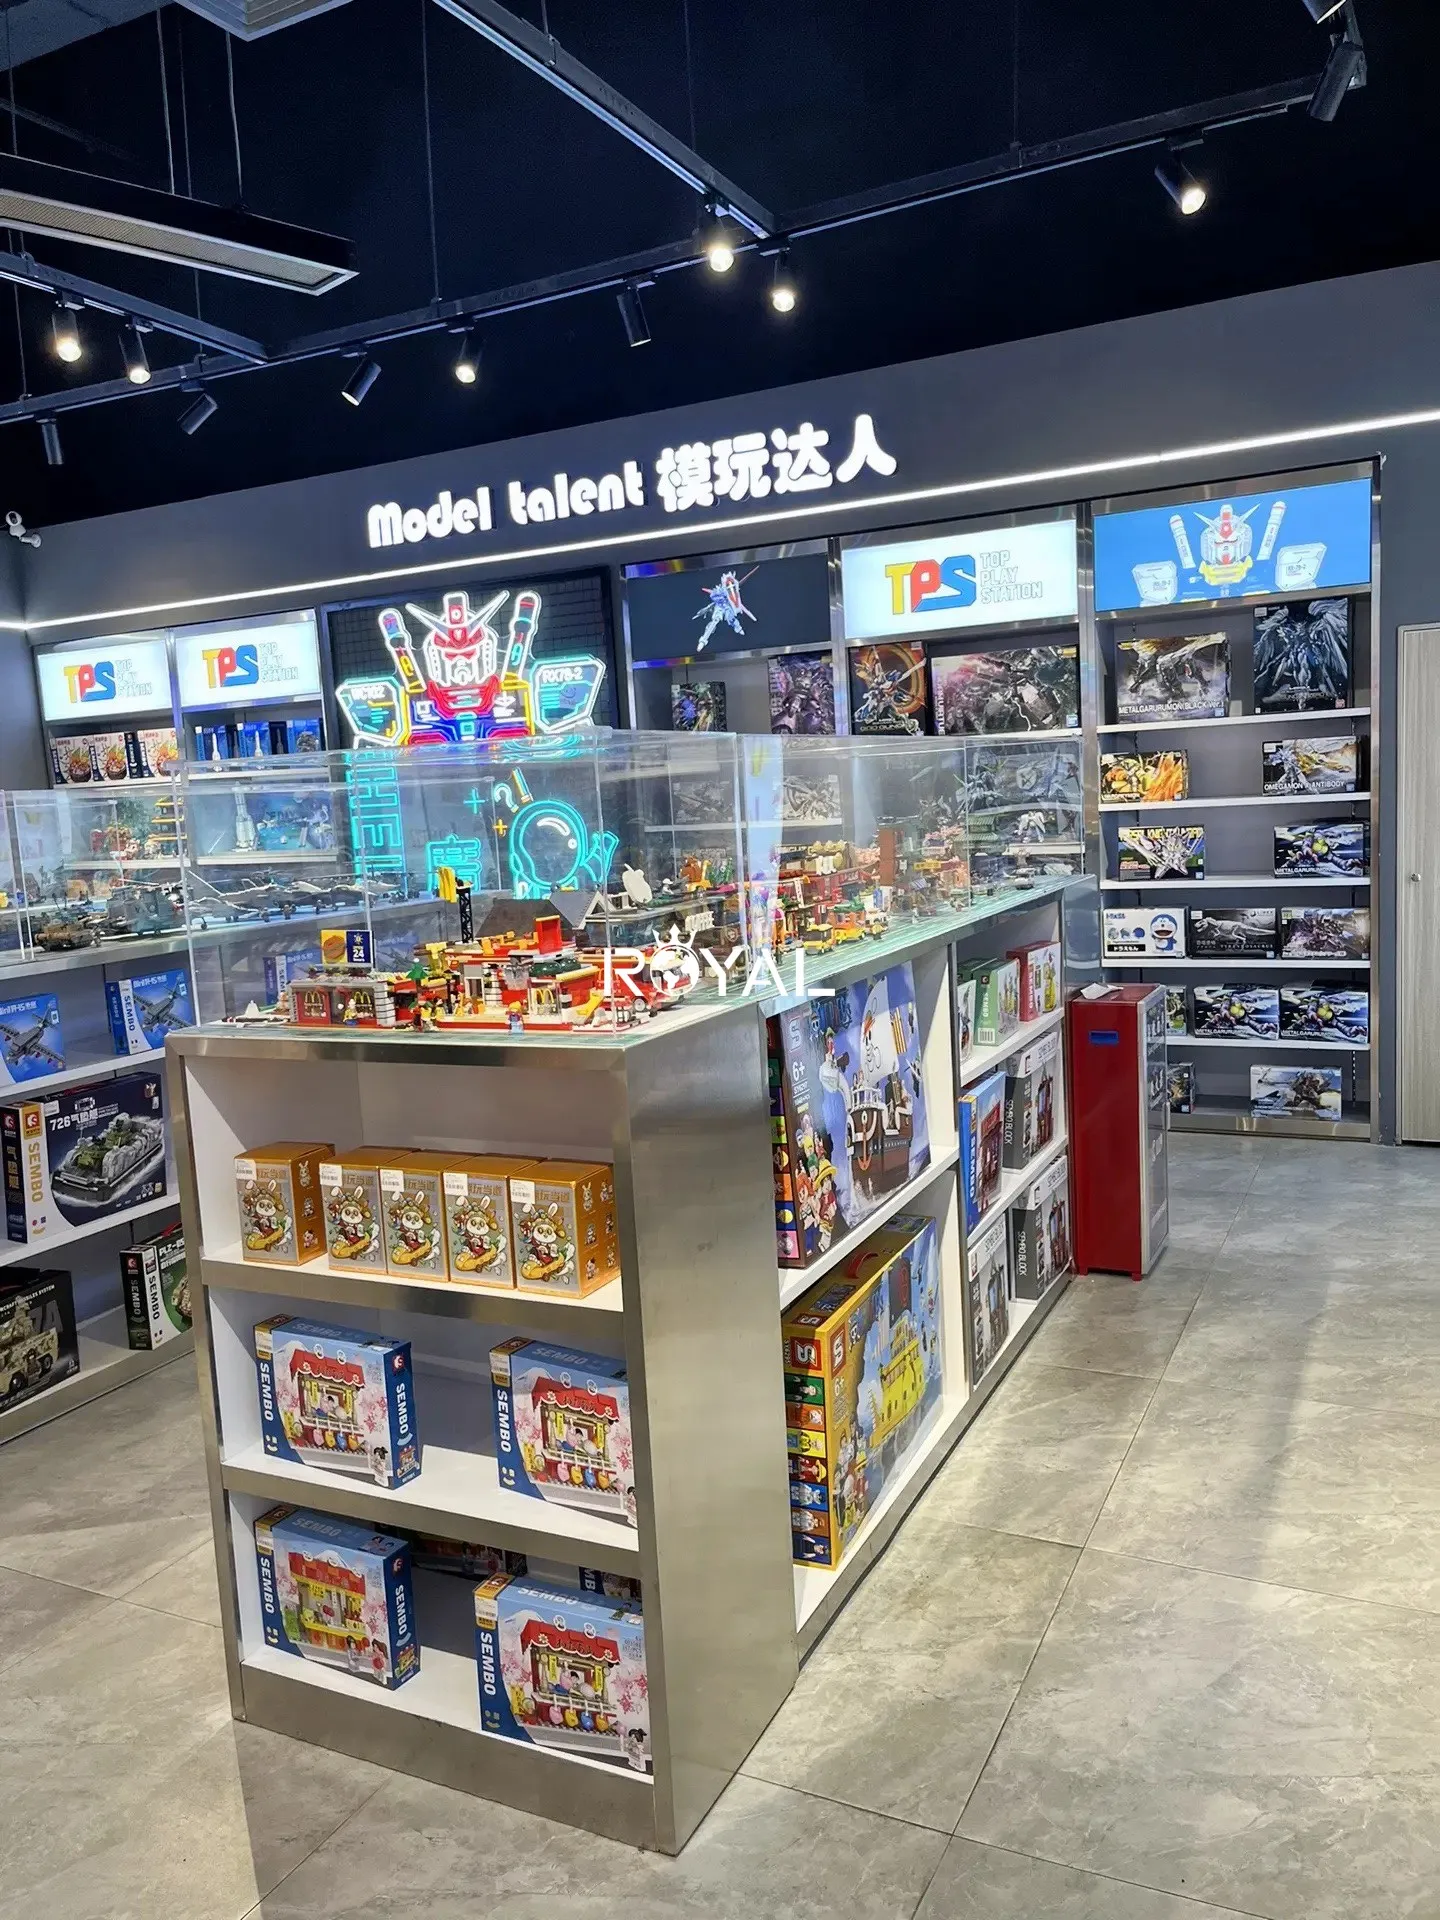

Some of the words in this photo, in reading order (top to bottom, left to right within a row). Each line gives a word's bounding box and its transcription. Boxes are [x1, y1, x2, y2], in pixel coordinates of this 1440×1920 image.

[656, 413, 897, 513] 模玩达人
[368, 486, 493, 548] Model
[509, 460, 645, 525] talent
[980, 550, 1010, 569] TOP
[980, 566, 1018, 587] PLAY
[885, 555, 977, 615] TPS
[981, 581, 1043, 604] STATION
[63, 661, 116, 704] TPS
[202, 644, 259, 689] TPS
[124, 995, 135, 1031] SEMBO
[792, 1061, 806, 1081] 6+
[1005, 1099, 1014, 1122] SEMBO
[1004, 1123, 1014, 1145] BLOCK
[28, 1142, 44, 1203] SEMBO
[969, 1136, 978, 1199] SEMBO
[1018, 1230, 1026, 1254] SEMBO
[1018, 1254, 1026, 1276] BLOCK
[39, 1284, 55, 1295] SYSTEM
[131, 1279, 141, 1316] SEMBO
[149, 1275, 160, 1320] SEMBO
[532, 1348, 588, 1365] SEMBO
[259, 1362, 274, 1421] SEMBO
[834, 1376, 845, 1397] 6+
[396, 1382, 409, 1435] SEMBO
[497, 1389, 511, 1453] SEMBO
[292, 1518, 342, 1537] SEMBO
[260, 1557, 275, 1614] SEMBO
[517, 1587, 579, 1605] SEMBO
[395, 1584, 408, 1635] SEMBO
[480, 1631, 497, 1696] SEMBO
